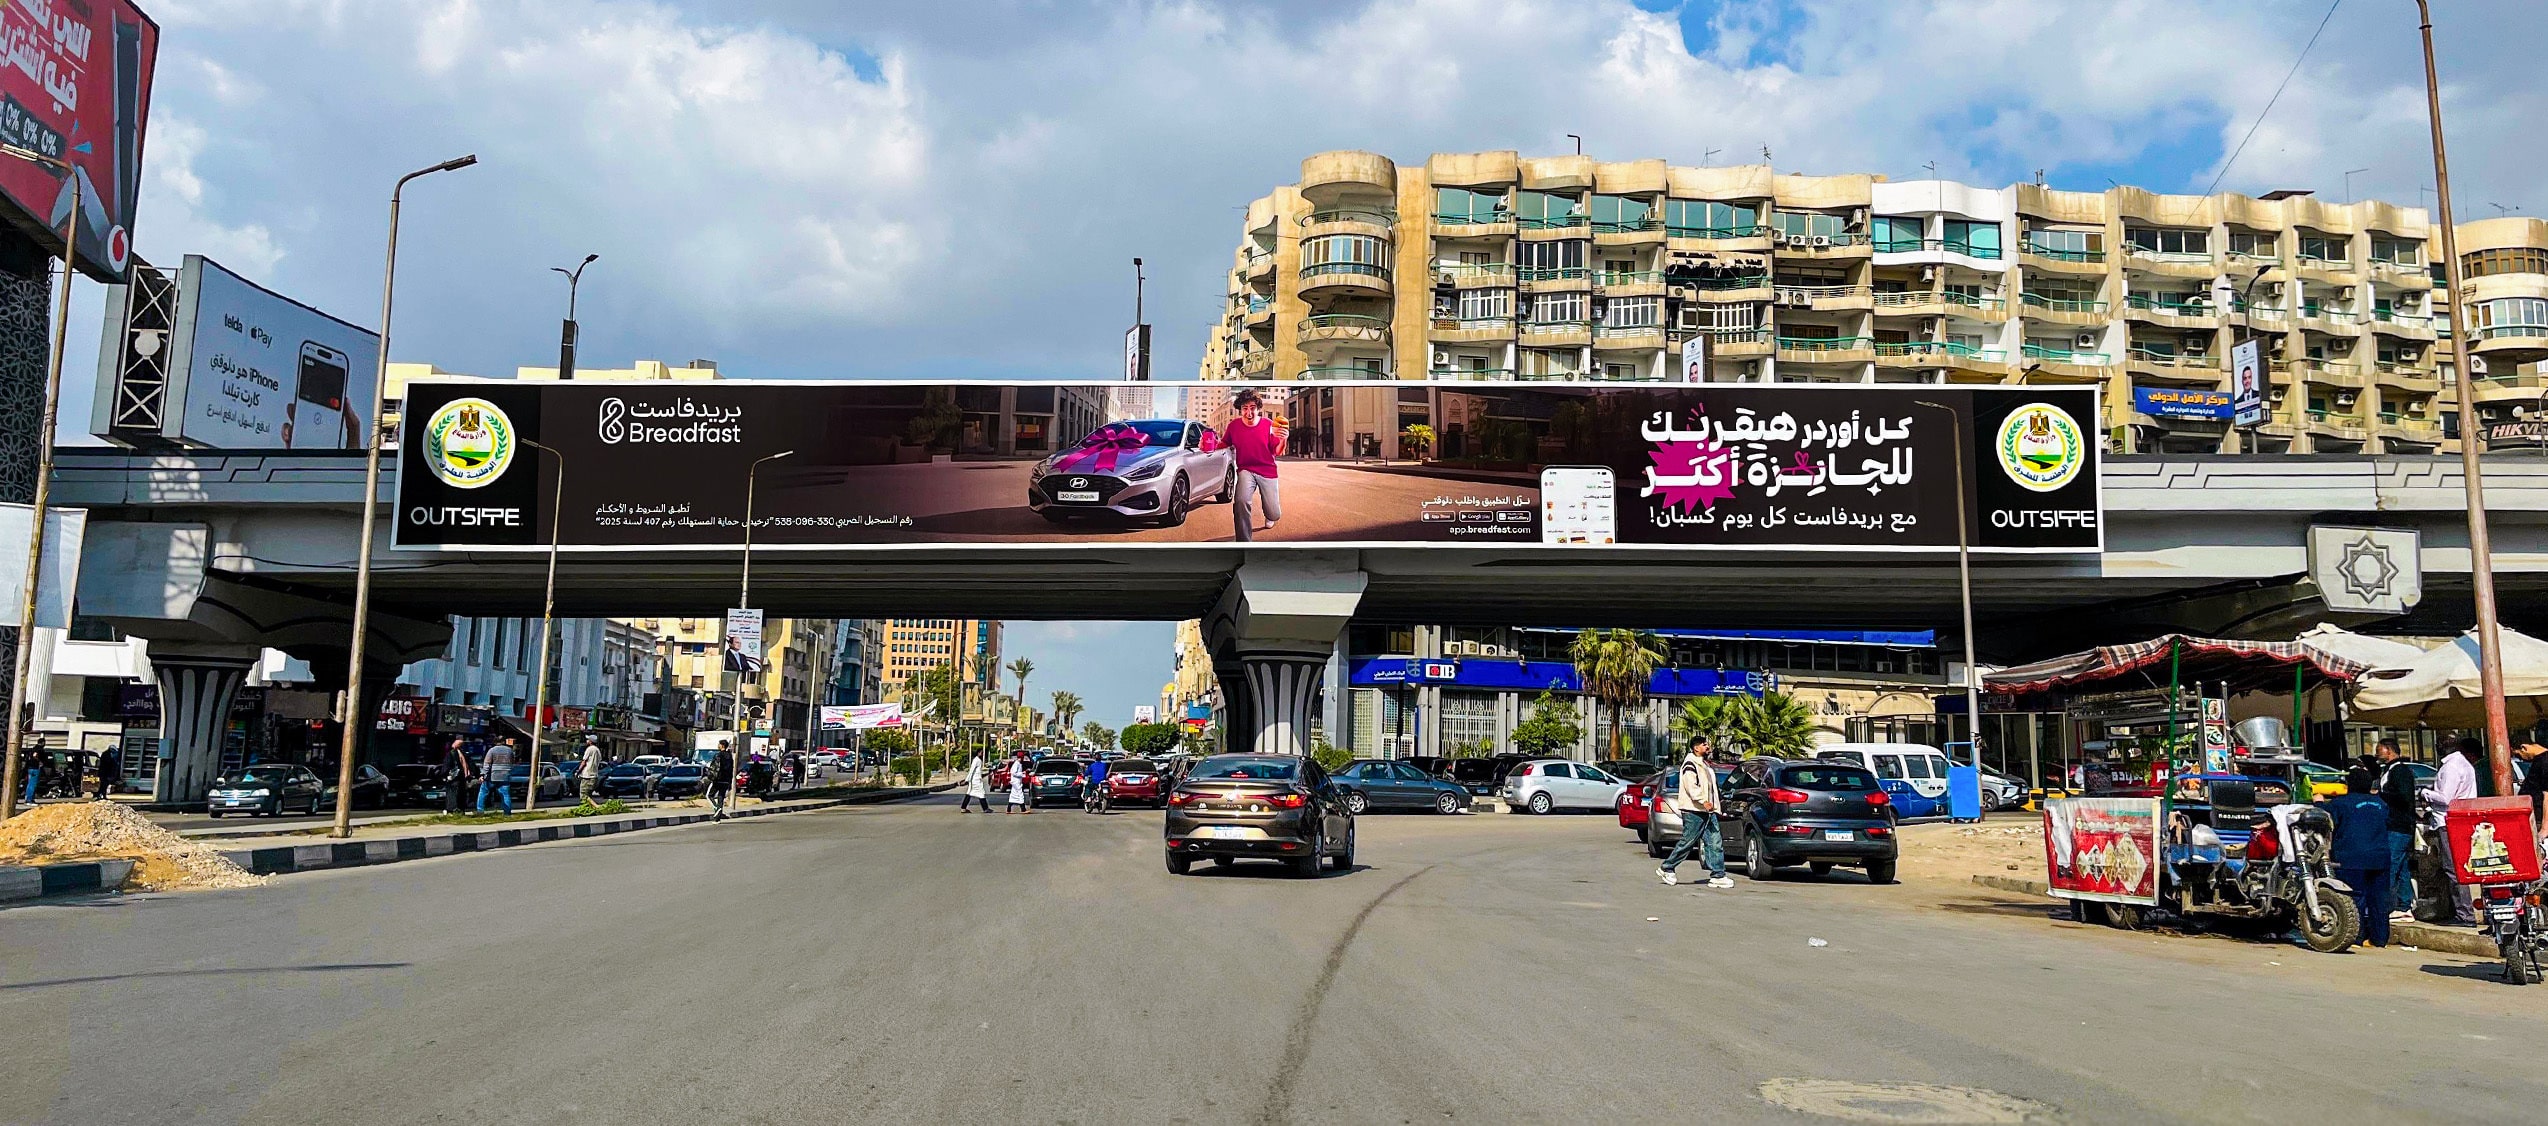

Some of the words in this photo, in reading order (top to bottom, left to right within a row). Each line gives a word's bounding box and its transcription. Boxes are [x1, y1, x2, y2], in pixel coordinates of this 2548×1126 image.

[44, 60, 77, 115] فيه
[23, 117, 38, 145] 0%
[41, 130, 57, 156] 0%
[224, 313, 243, 334] telda
[257, 327, 273, 349] Pay
[236, 366, 248, 379] هو
[249, 367, 279, 391] iPhone
[241, 390, 261, 408] كارت
[2205, 395, 2229, 406] مركز
[630, 397, 742, 423] بريدفاست
[630, 422, 741, 444] Breadfast
[1800, 409, 1860, 449] أوردر
[1864, 416, 1913, 446] كل
[439, 461, 464, 478] للطرق
[467, 461, 497, 479] الوطنية
[2013, 465, 2039, 482] للطرق
[2041, 464, 2069, 482] الوطنية
[1455, 496, 1480, 506] واطلب
[1482, 496, 1510, 507] التطبيق
[661, 518, 676, 528] رقم
[717, 517, 739, 527] حماية
[864, 515, 898, 526] التسجيل
[899, 516, 913, 527] رقم
[1650, 506, 1715, 529] كسبان!
[1722, 513, 1753, 531] يوم
[1760, 506, 1787, 528] كل
[1794, 508, 1883, 530] بريدفاست
[1889, 512, 1917, 533] مع
[1450, 526, 1531, 534] app.breadfast.com
